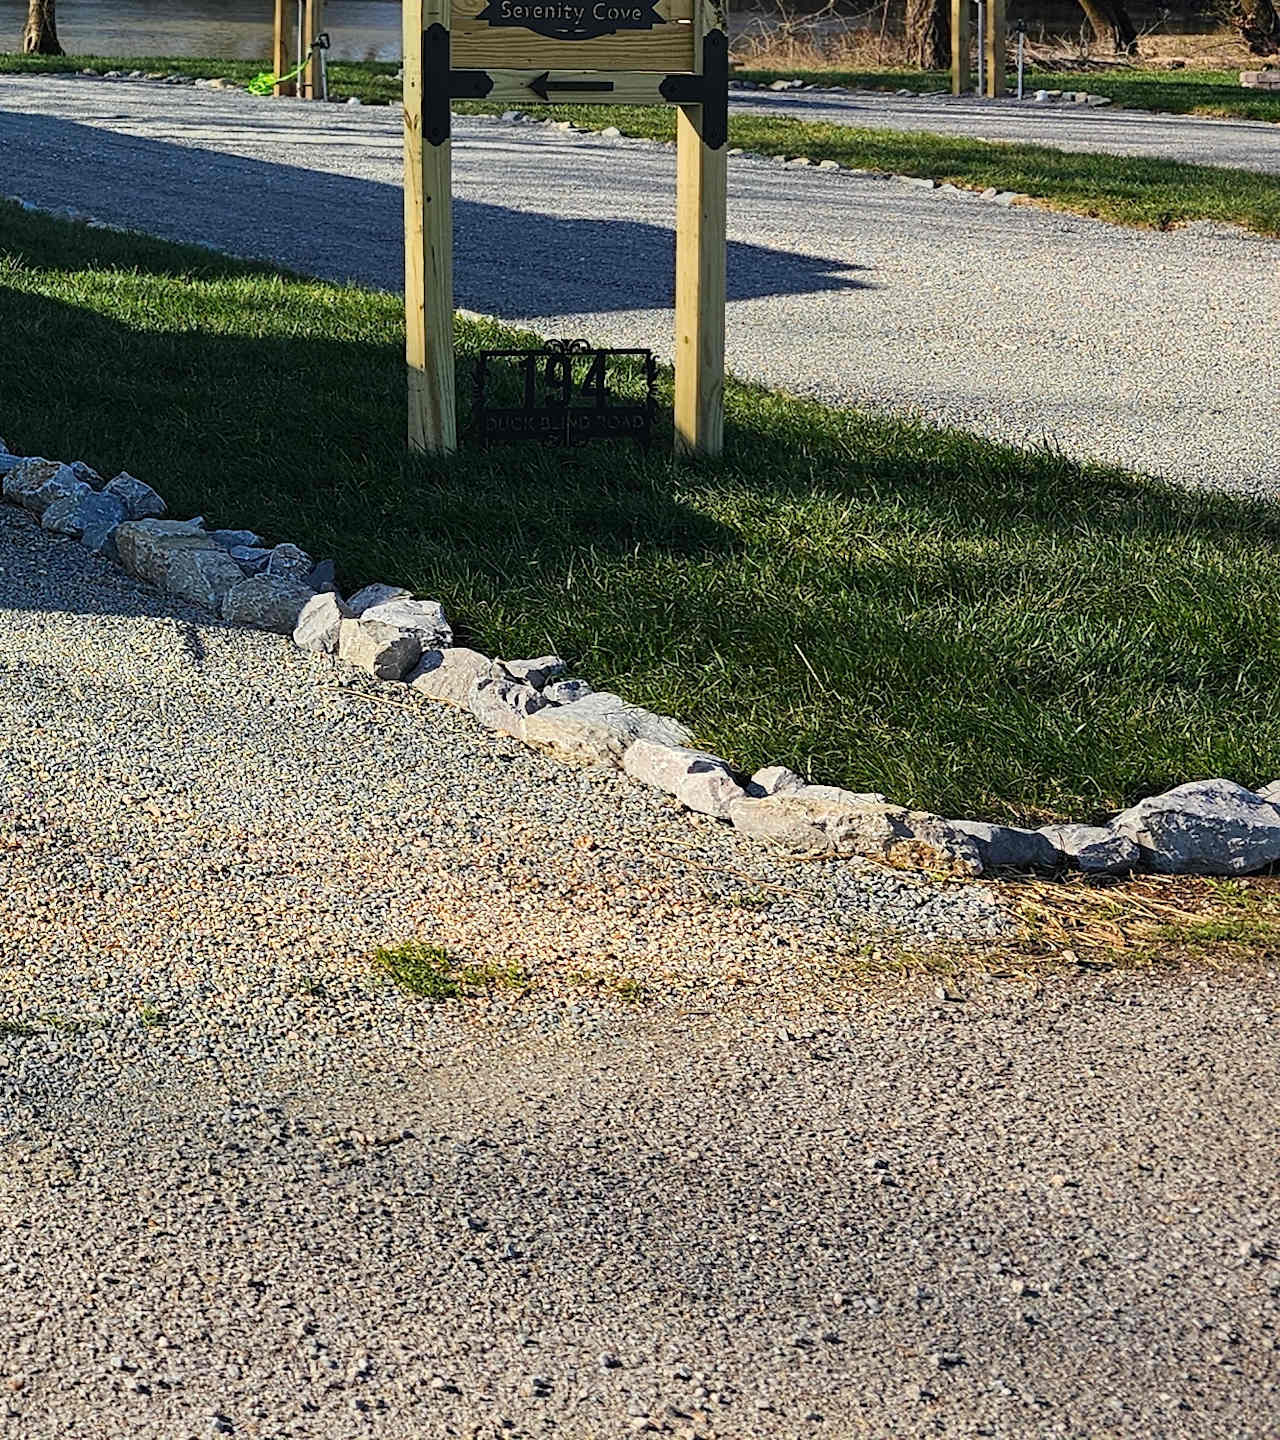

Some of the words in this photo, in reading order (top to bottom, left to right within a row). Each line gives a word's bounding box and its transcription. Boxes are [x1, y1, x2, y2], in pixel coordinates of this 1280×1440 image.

[501, 0, 584, 24] Serenity
[593, 2, 642, 20] Cove
[518, 353, 610, 408] 194
[487, 415, 536, 432] DUCK
